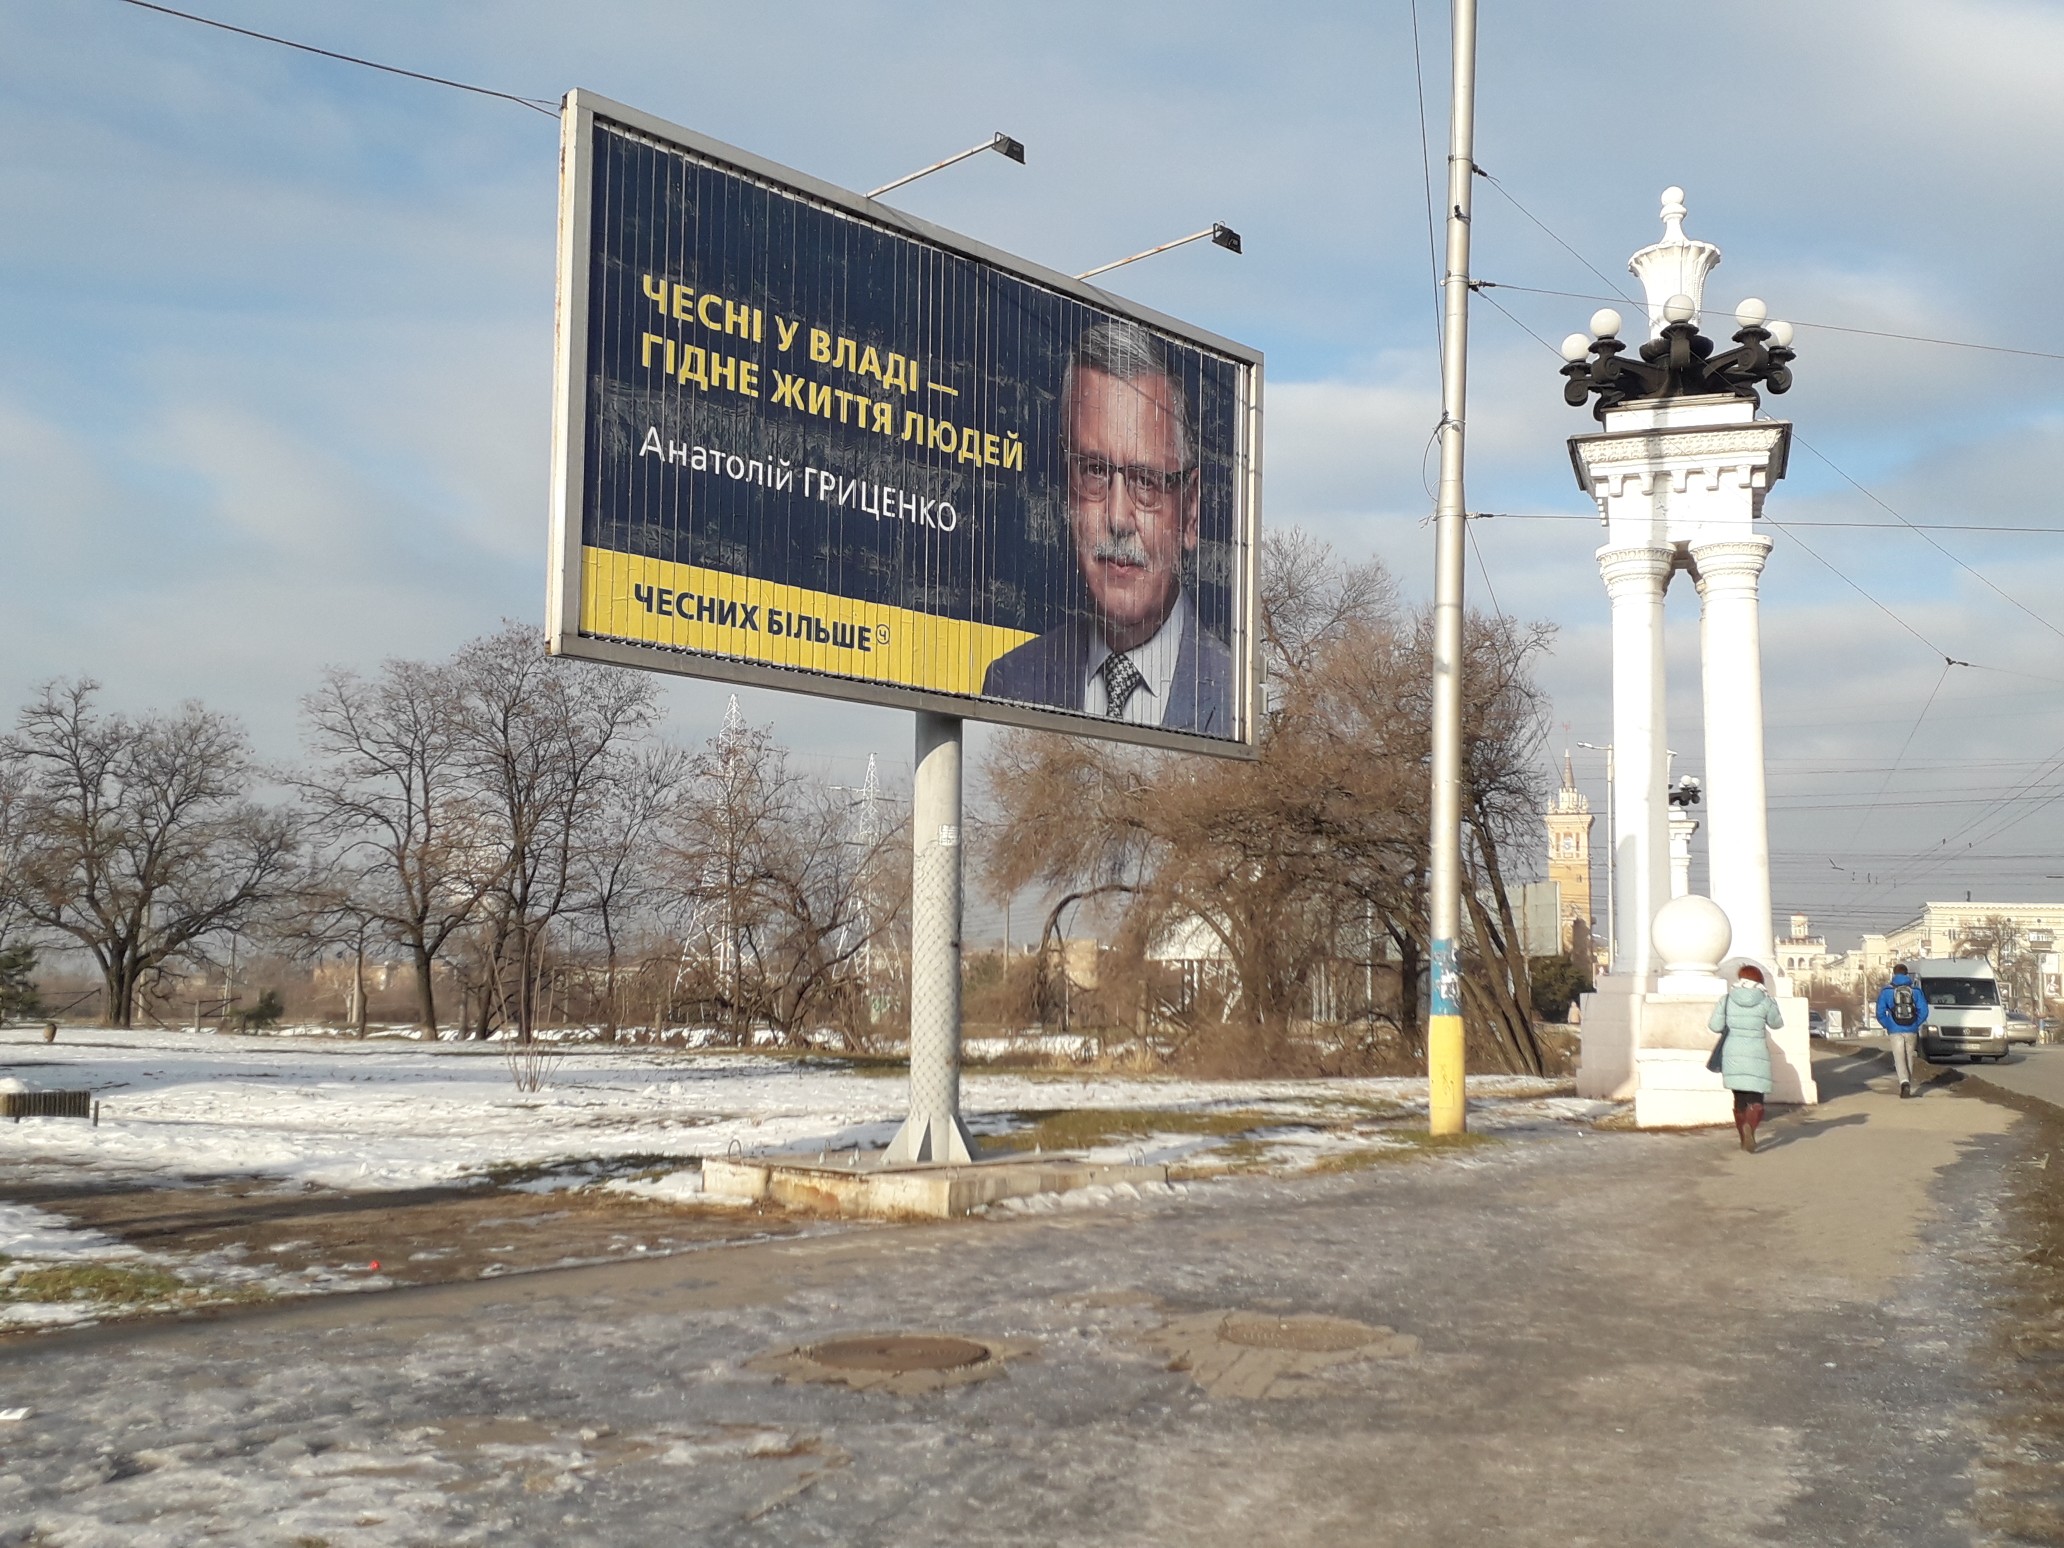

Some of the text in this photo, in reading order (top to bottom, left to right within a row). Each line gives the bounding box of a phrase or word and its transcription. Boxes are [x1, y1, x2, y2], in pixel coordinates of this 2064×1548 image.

[643, 274, 762, 343] ЧЕСНІ
[774, 315, 799, 352] У
[810, 329, 918, 396] ВЛАДІ
[642, 332, 1023, 472] ГІДНЕ ЖИТТЯ ЛЮДЕЙ
[639, 426, 957, 532] Анатолій ГРИЦЕНКО
[634, 583, 759, 632] ЧЕСНИХ
[768, 608, 872, 651] БІЛЬШЕ
